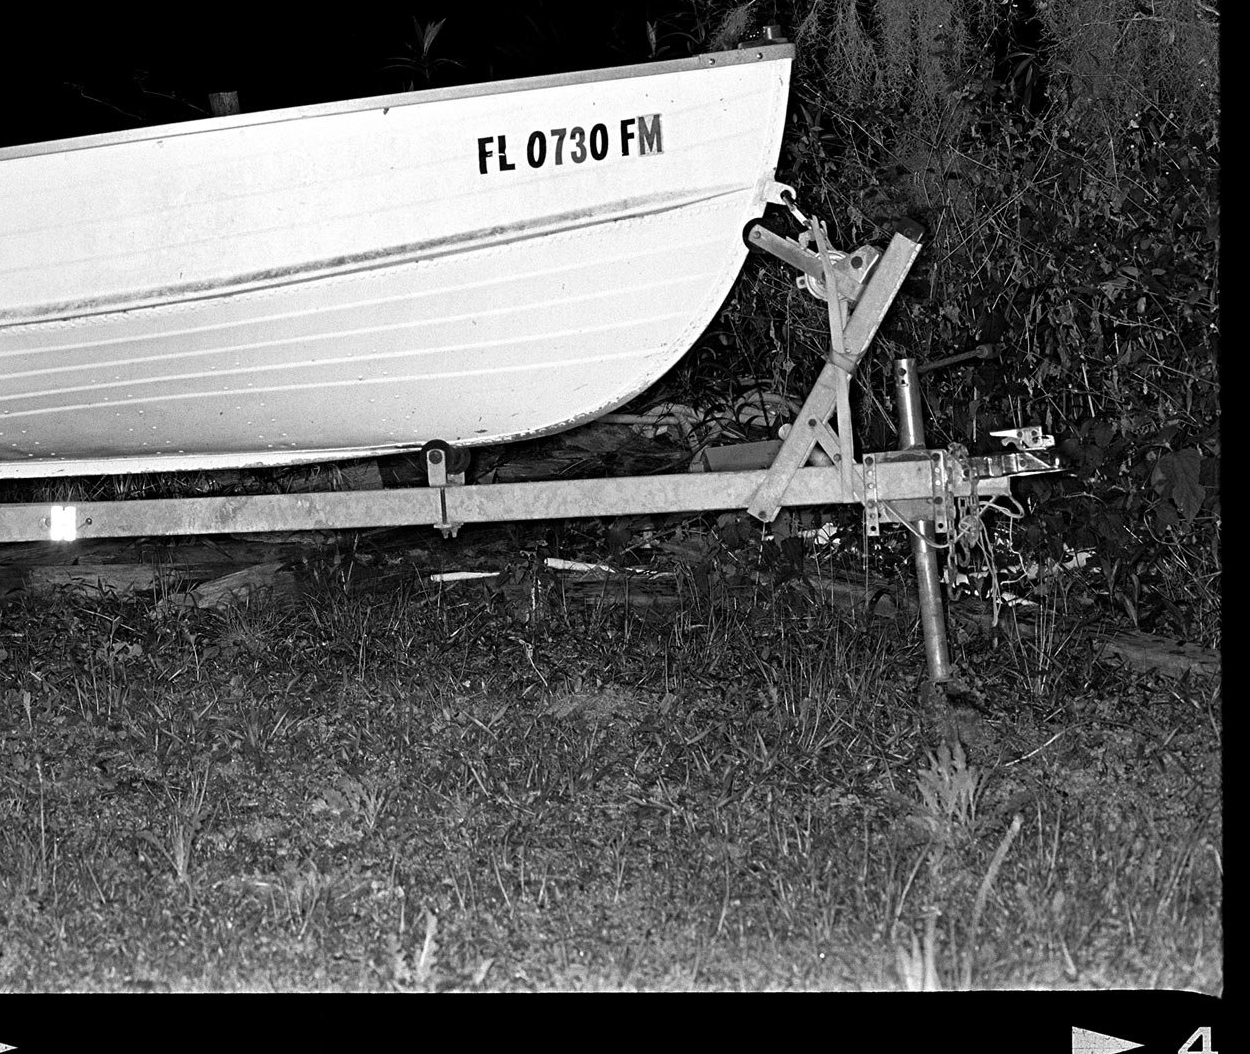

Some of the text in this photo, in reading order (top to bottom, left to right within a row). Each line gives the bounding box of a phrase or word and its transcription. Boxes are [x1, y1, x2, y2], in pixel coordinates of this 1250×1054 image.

[477, 113, 663, 174] FL 0730 FM
[1178, 1027, 1218, 1054] 4
